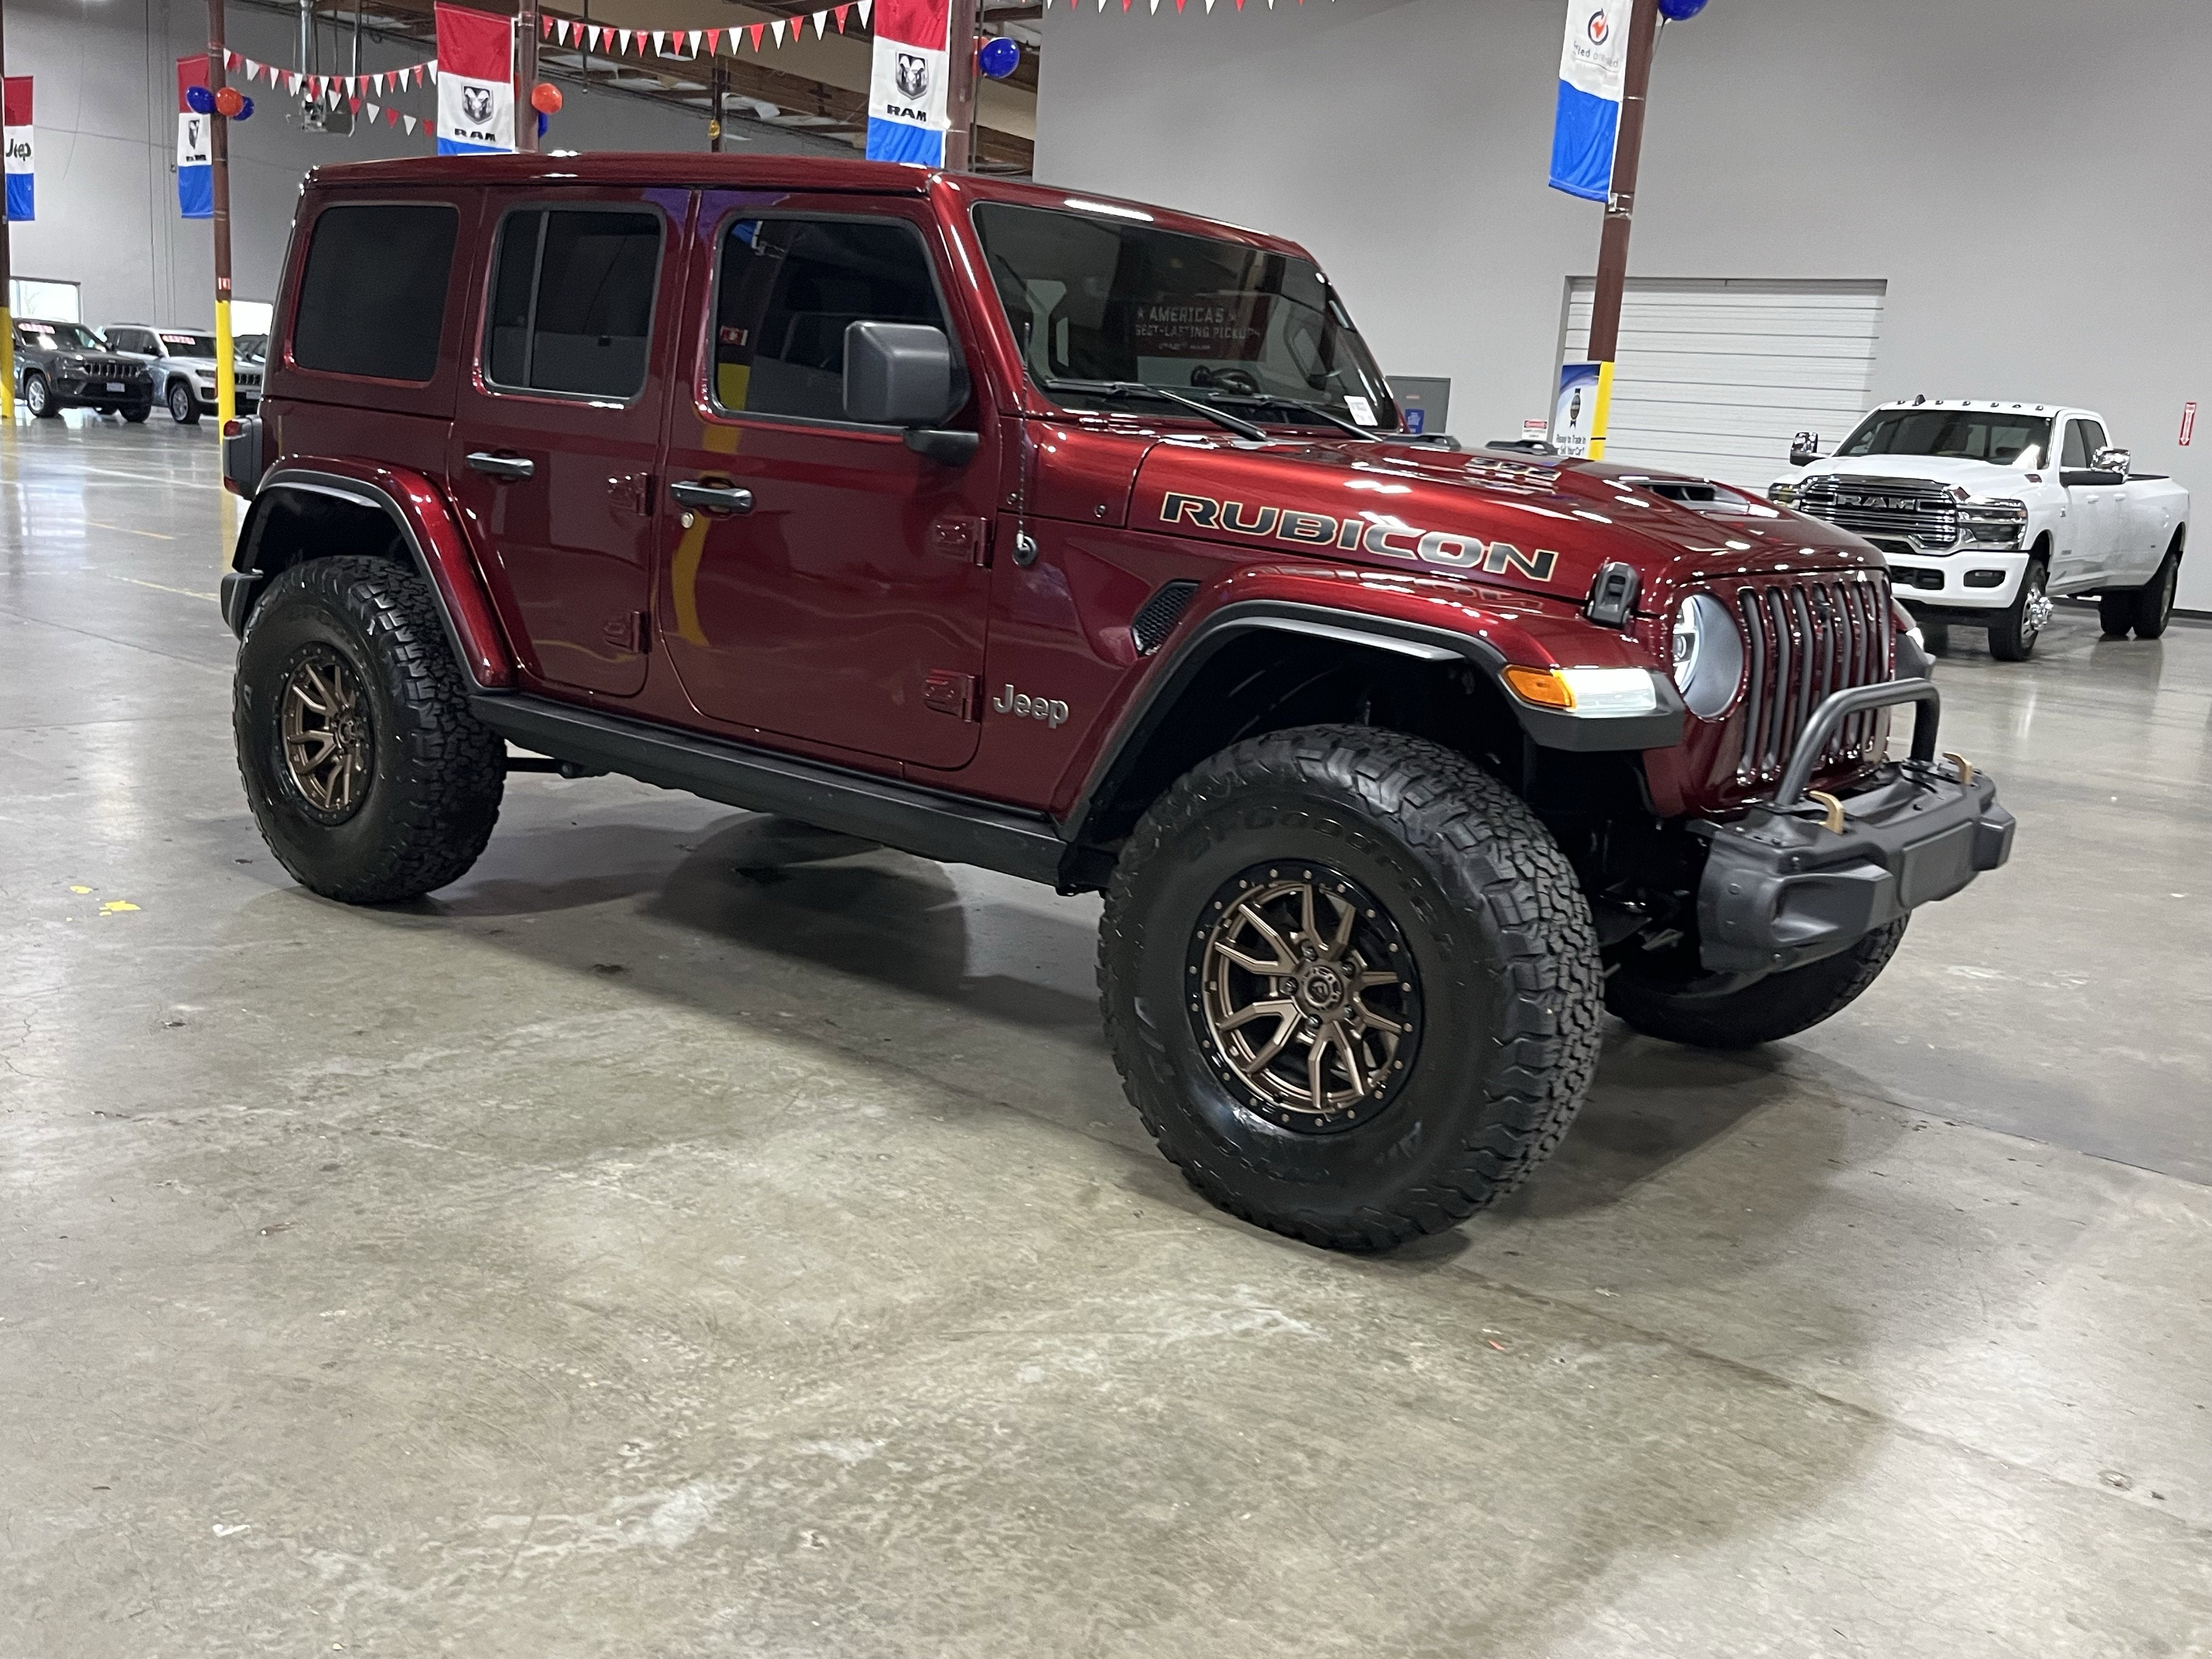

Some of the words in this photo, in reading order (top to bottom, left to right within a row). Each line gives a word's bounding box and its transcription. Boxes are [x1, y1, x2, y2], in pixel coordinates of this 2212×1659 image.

[887, 104, 927, 122] RAM
[454, 128, 496, 142] RAM
[5, 138, 32, 162] Jeep
[1837, 494, 1914, 511] RAM
[1159, 491, 1559, 582] RUBICON
[992, 684, 1069, 730] Jeep
